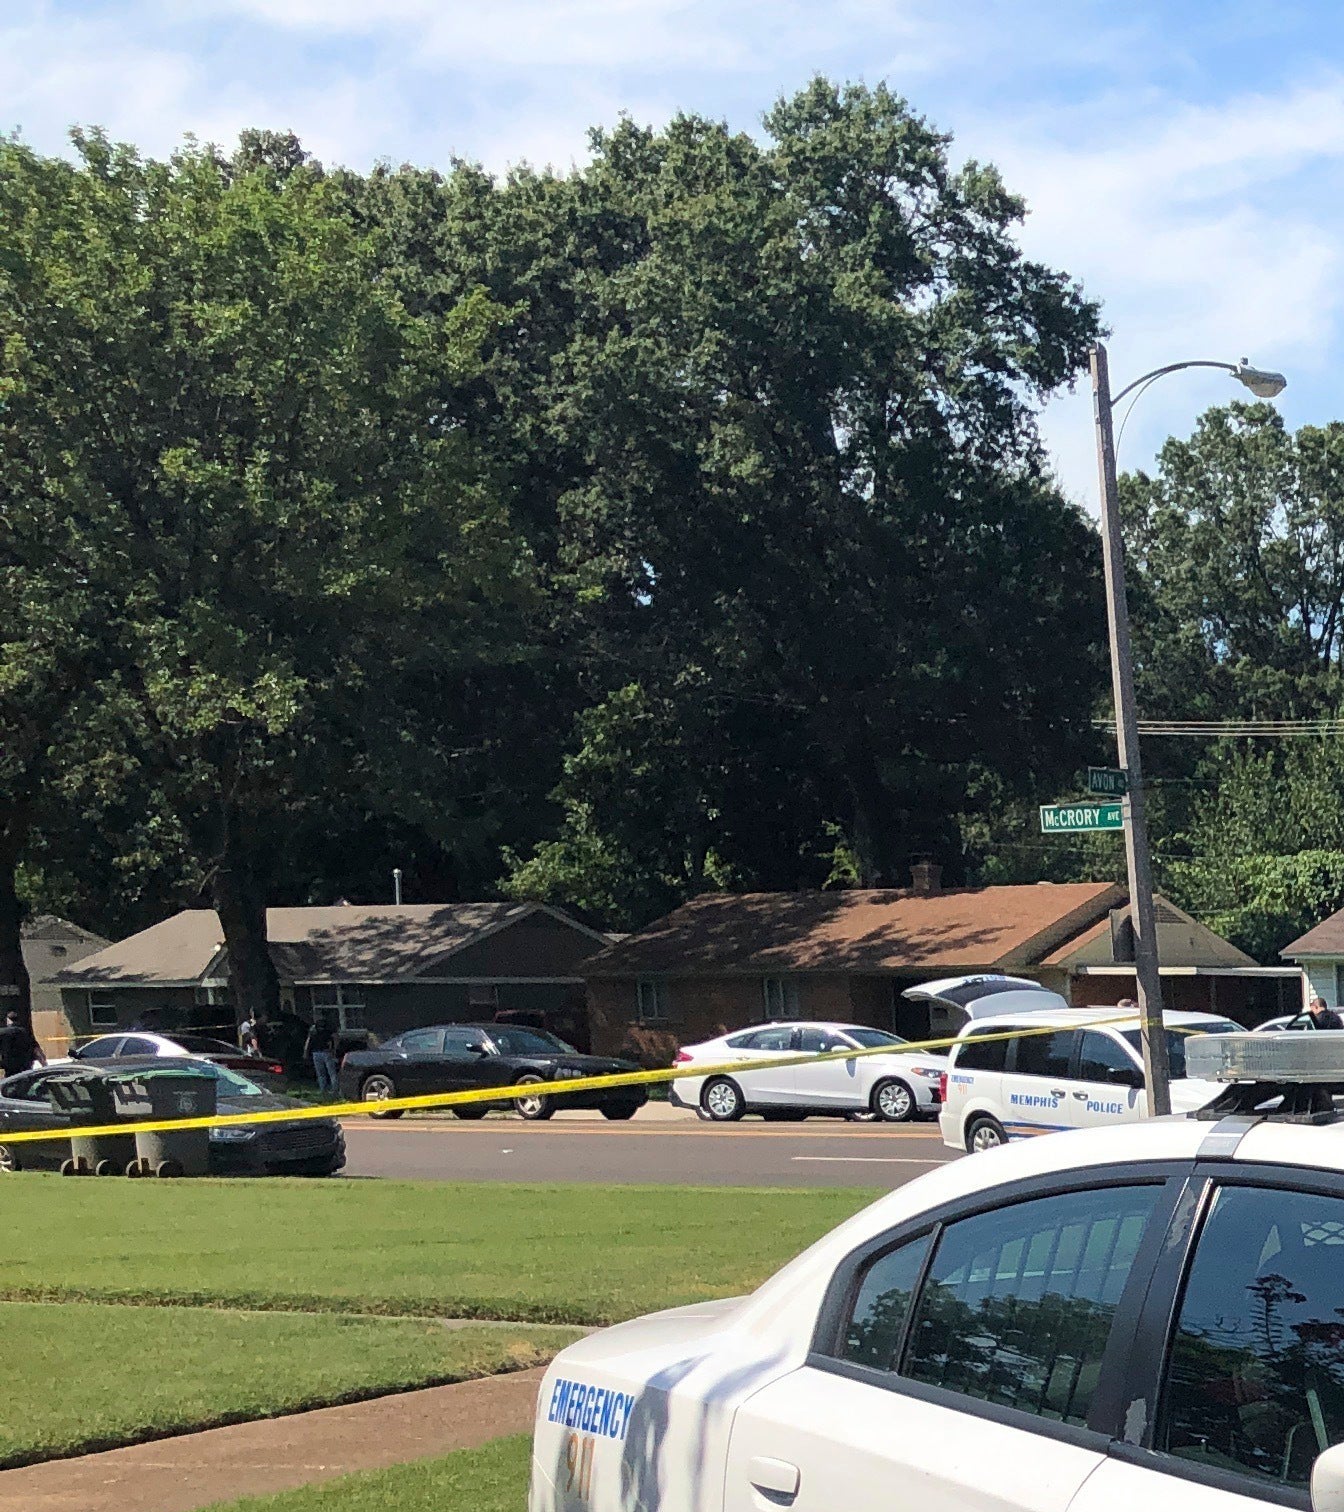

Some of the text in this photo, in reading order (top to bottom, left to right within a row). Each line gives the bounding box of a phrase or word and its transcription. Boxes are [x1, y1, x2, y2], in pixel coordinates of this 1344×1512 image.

[1091, 772, 1115, 790] AVON
[1044, 808, 1100, 827] McCRORY
[1010, 1094, 1123, 1115] MEMPHIS POLICE
[548, 1379, 635, 1440] EMERGENCY
[566, 1432, 595, 1500] 911
